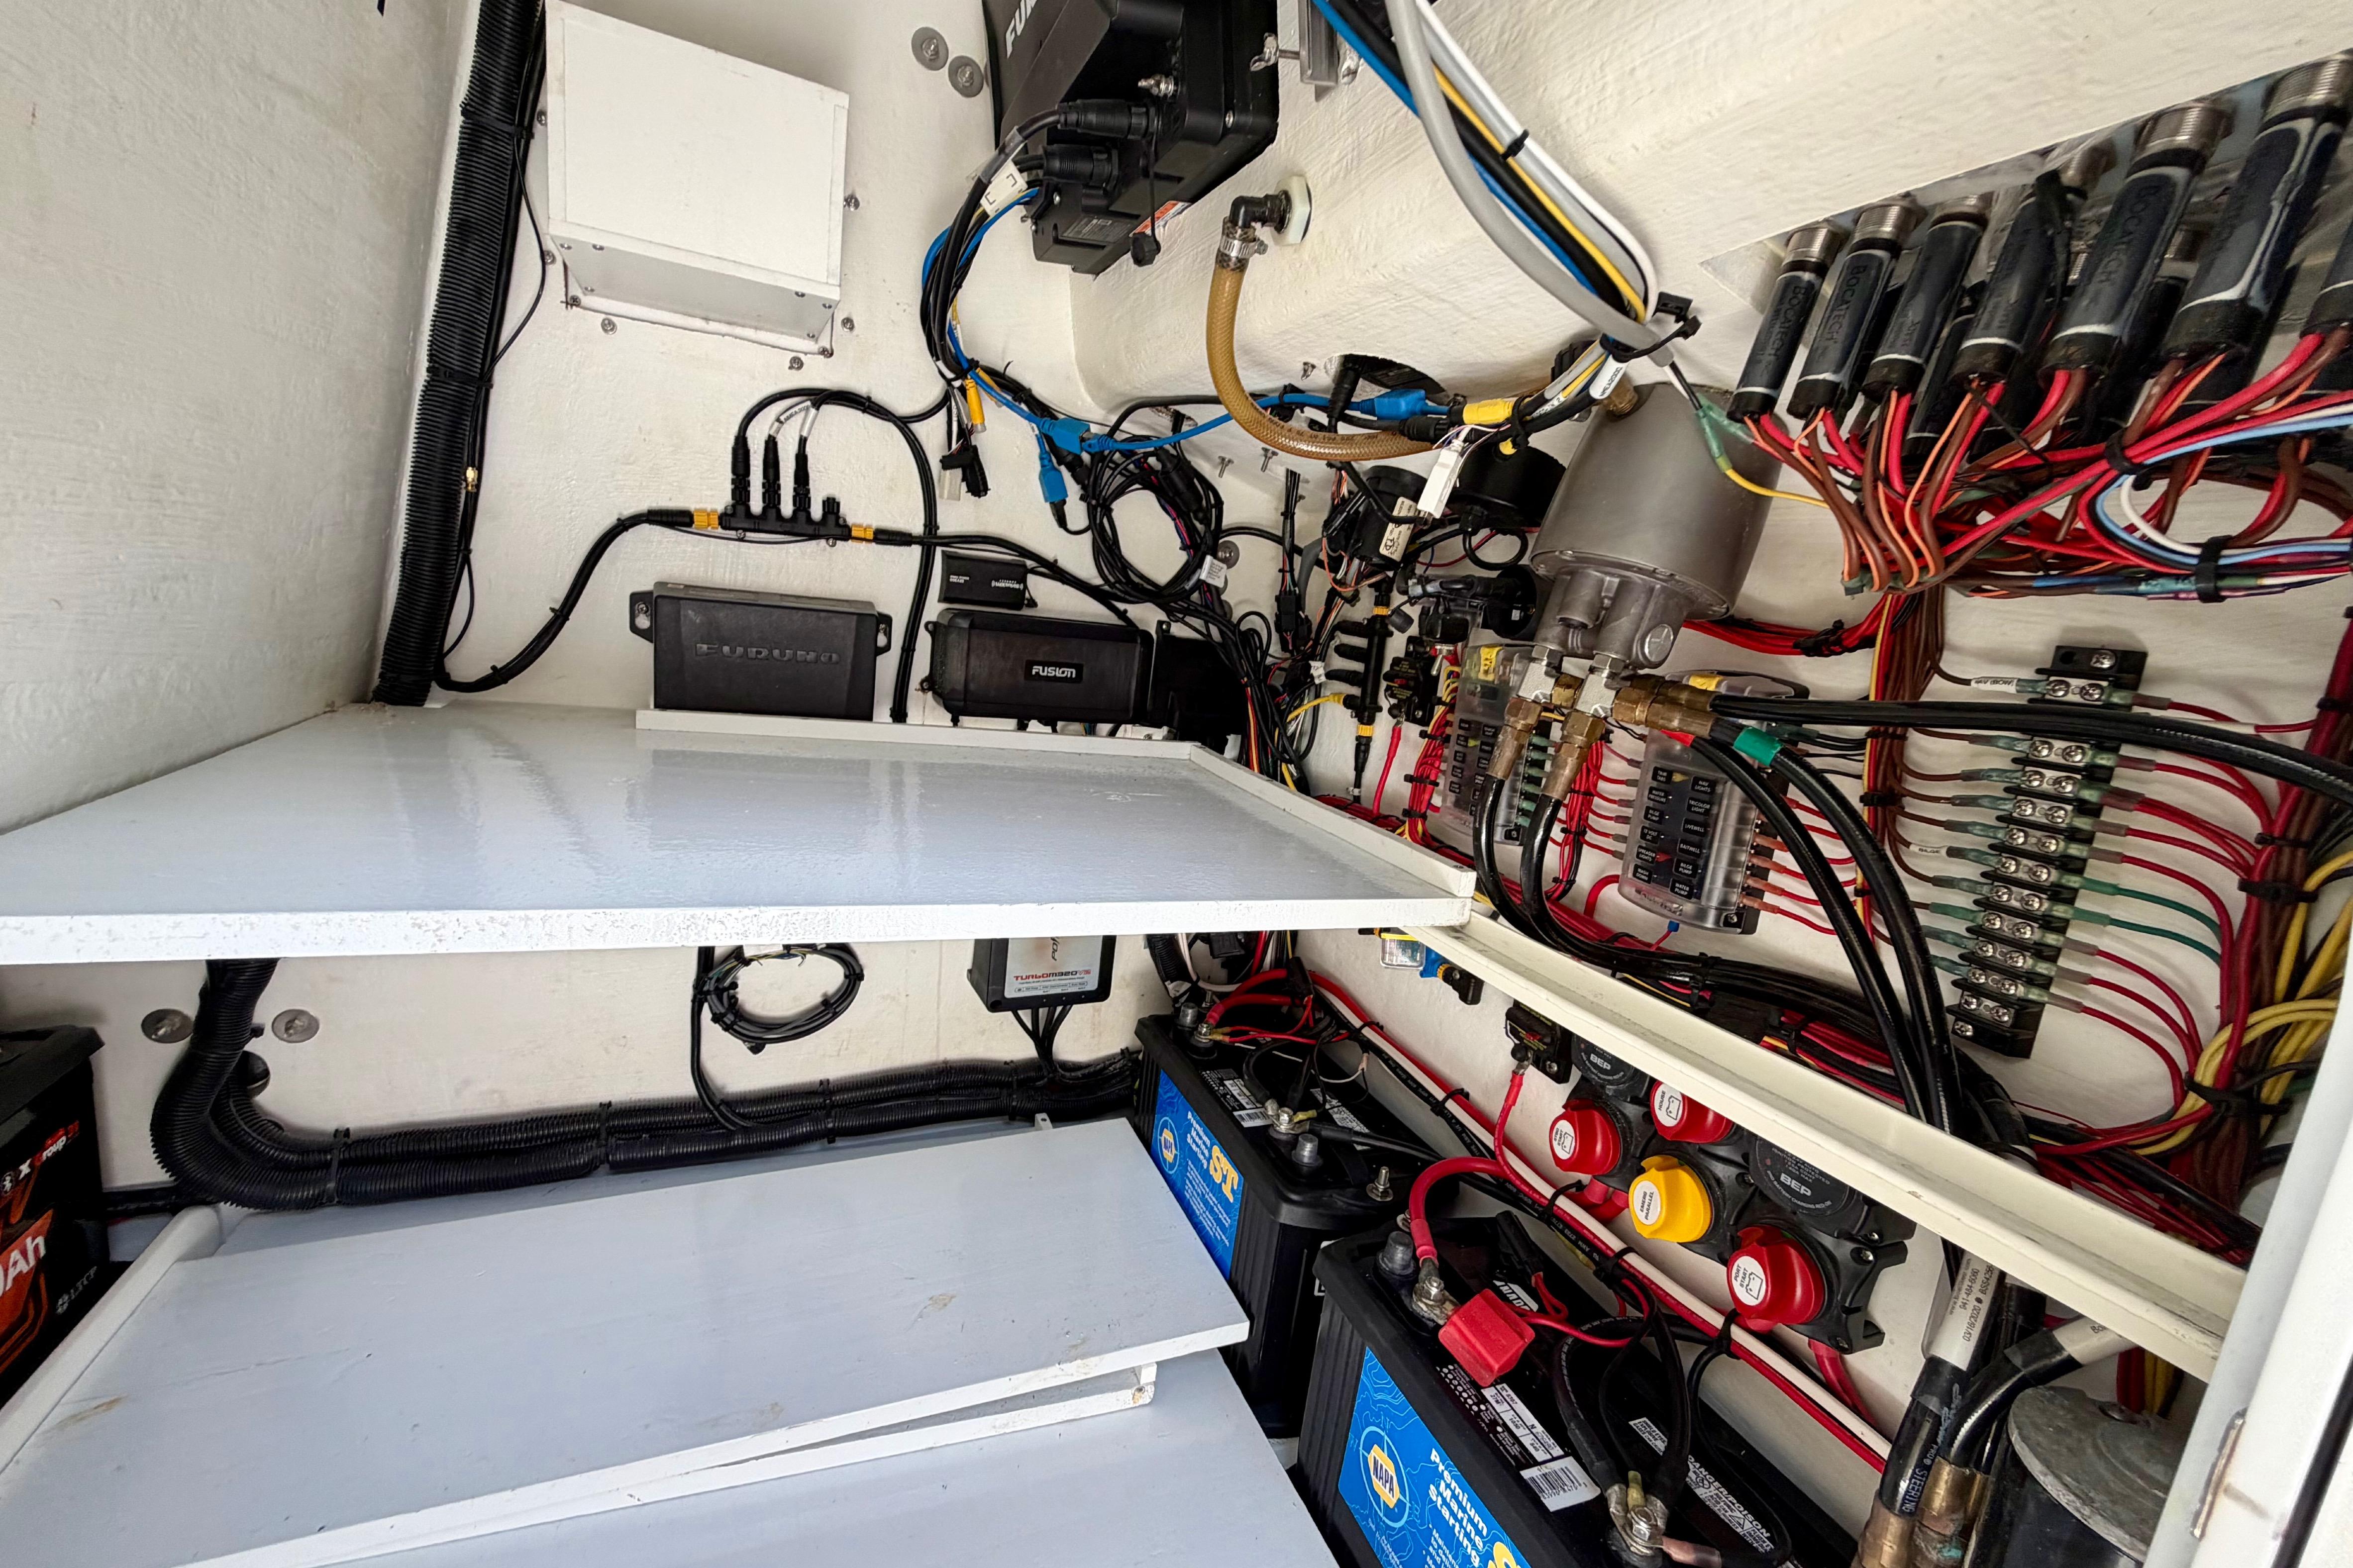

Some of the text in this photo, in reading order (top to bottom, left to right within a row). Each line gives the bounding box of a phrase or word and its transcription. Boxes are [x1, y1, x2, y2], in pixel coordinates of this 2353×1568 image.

[695, 643, 841, 664] FURUNO
[1032, 666, 1076, 678] FUSION
[1689, 800, 1710, 809] TRICOLOR
[1685, 823, 1704, 832] LIVEWELL
[1680, 843, 1700, 854] BAITWELL
[1675, 883, 1689, 891] WATER
[1590, 1053, 1611, 1071] BEP
[1188, 1111, 1211, 1147] Premium
[1187, 1133, 1208, 1169] Starting
[1191, 1127, 1209, 1158] Marine
[1210, 1145, 1239, 1203] ST
[1780, 1173, 1812, 1196] BEP
[1797, 1163, 1831, 1185] PROTECTED
[1801, 1174, 1813, 1183] MAX
[1644, 1191, 1654, 1220] PARALLEL
[1739, 1268, 1748, 1288] START
[1962, 1305, 1981, 1342] 03/16/2020
[1372, 1456, 1395, 1499] NAPA
[1430, 1448, 1487, 1537] Premium
[1687, 1454, 1770, 1538] DANGER/POISON
[1902, 1468, 1928, 1513] STEERING
[1429, 1484, 1480, 1568] Starting
[1439, 1479, 1483, 1551] Marine
[1431, 1536, 1438, 1550] to
[1429, 1545, 1441, 1565] and
